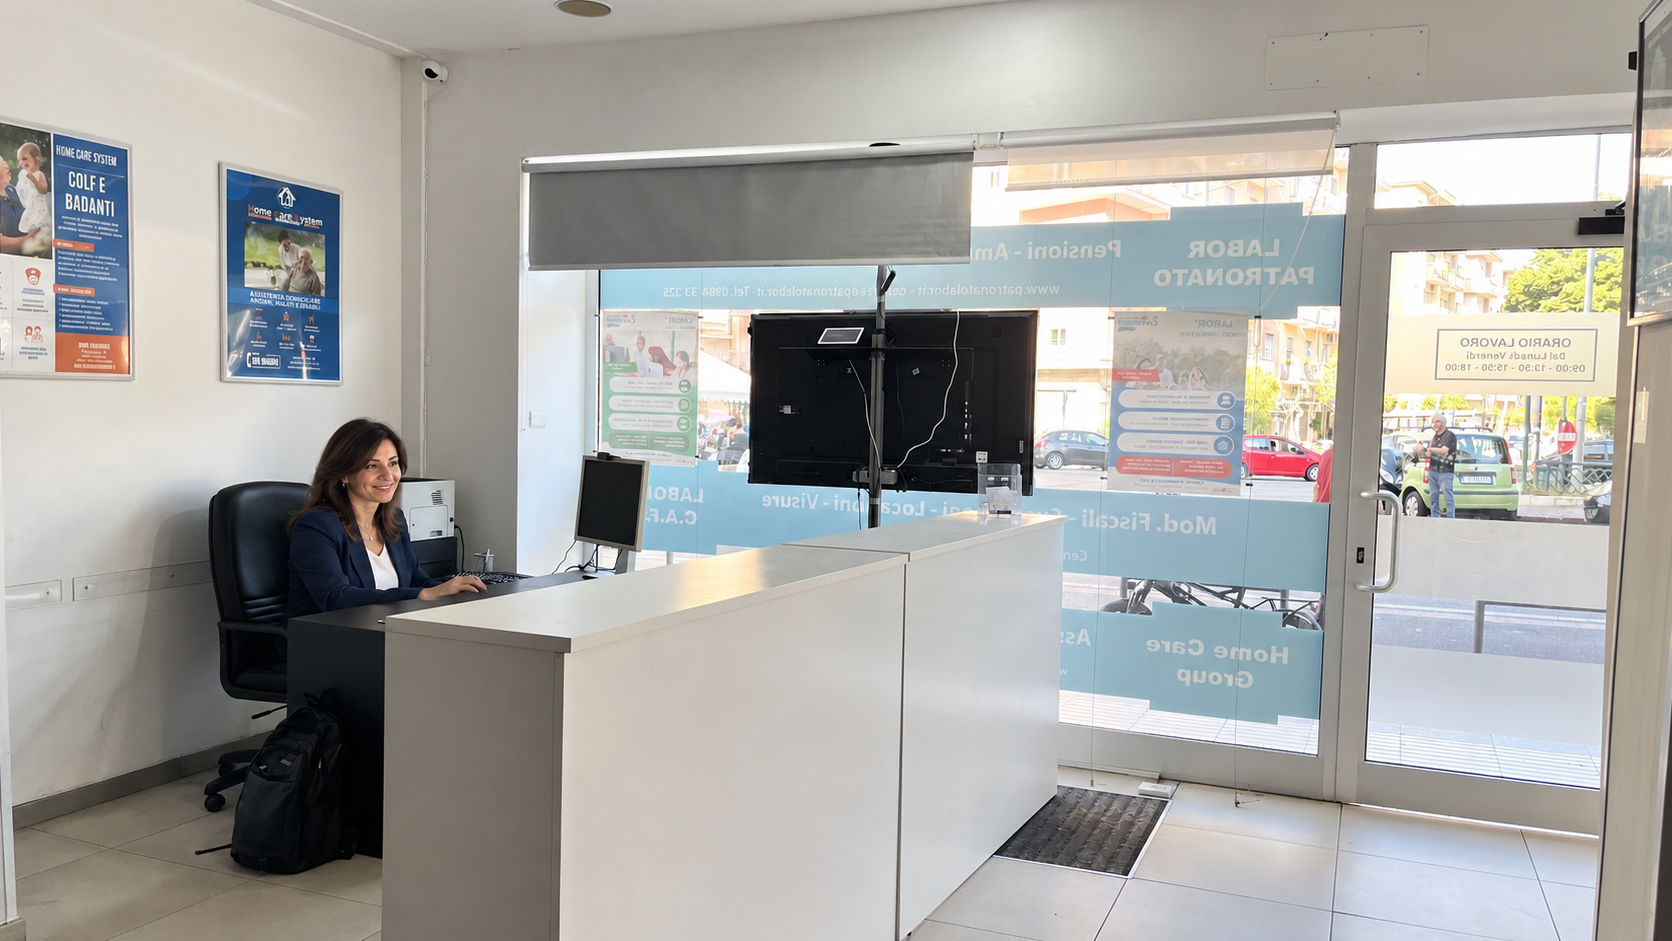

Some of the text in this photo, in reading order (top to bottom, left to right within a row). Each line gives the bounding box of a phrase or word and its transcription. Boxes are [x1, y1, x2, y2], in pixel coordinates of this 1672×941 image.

[56, 145, 117, 167] HOME CARE SYSTEM
[68, 171, 106, 194] COLF E
[65, 193, 115, 218] BADANTI
